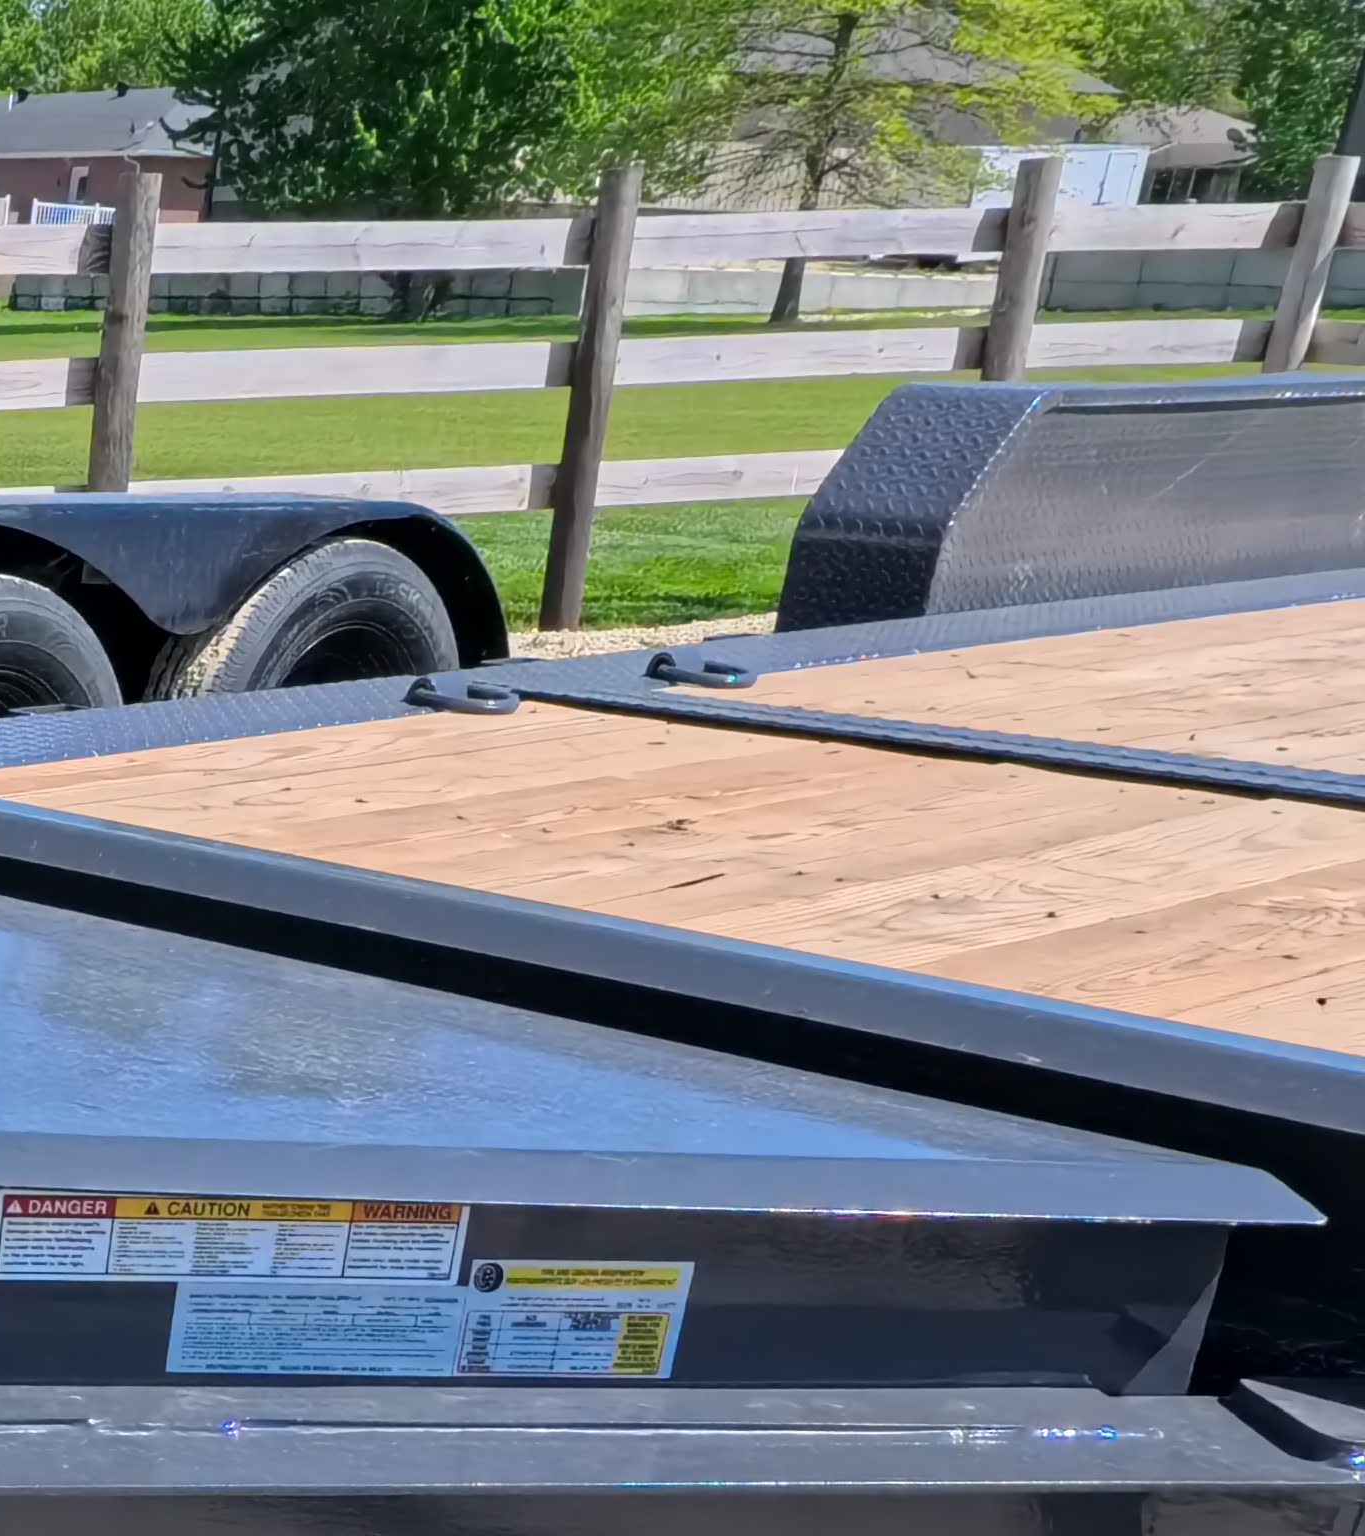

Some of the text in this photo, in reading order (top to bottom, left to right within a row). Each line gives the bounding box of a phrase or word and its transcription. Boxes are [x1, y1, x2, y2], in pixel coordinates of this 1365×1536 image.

[29, 1200, 108, 1215] DANGER
[167, 1201, 250, 1217] CAUTION
[363, 1204, 452, 1220] WARNING
